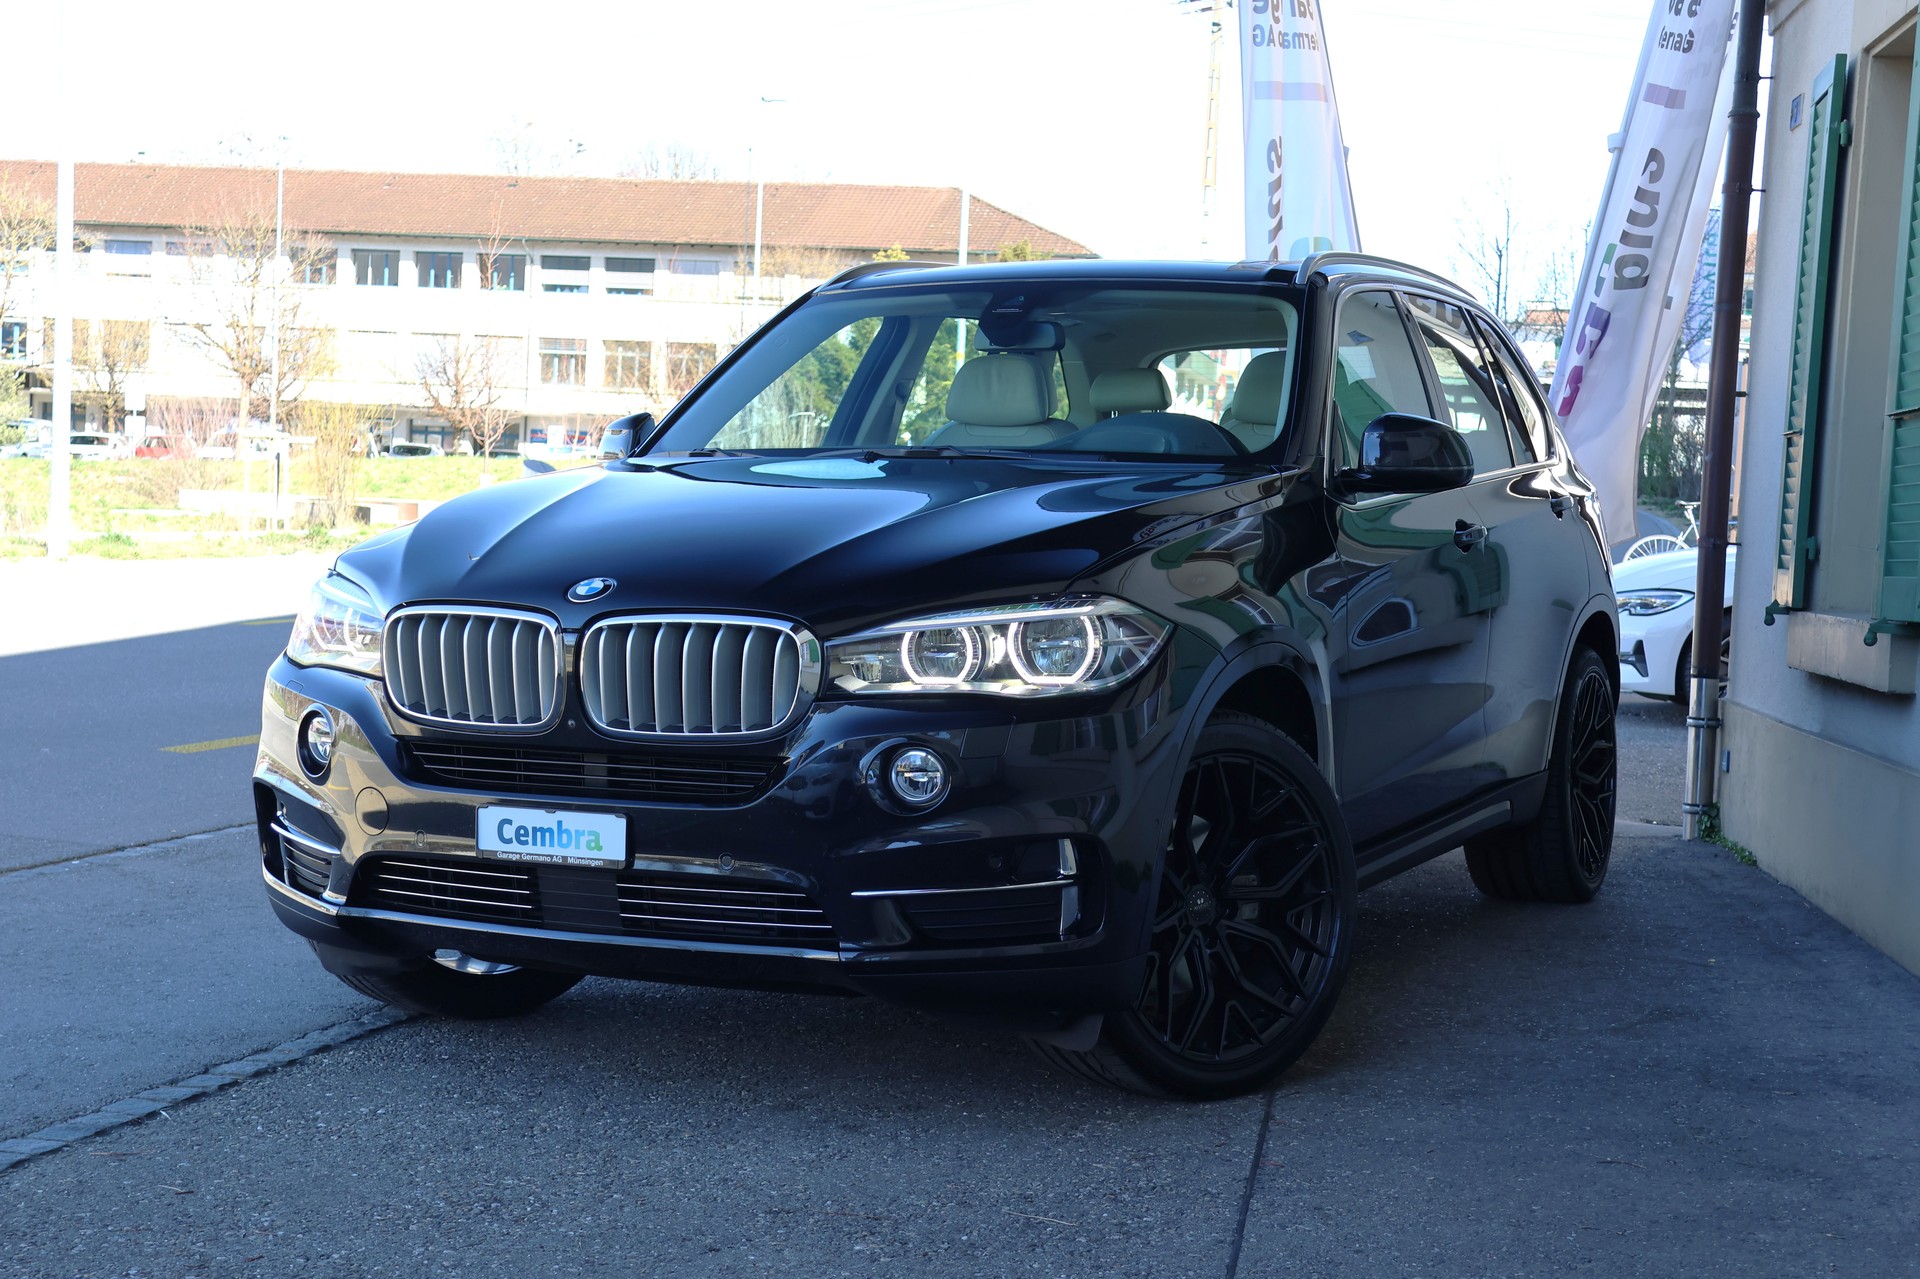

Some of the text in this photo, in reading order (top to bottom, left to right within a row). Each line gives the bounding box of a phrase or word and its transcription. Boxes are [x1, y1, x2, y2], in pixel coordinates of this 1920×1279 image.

[1614, 148, 1665, 291] plus
[497, 818, 603, 852] Cembra
[497, 851, 603, 867] Garage Germano AG Münsingen
